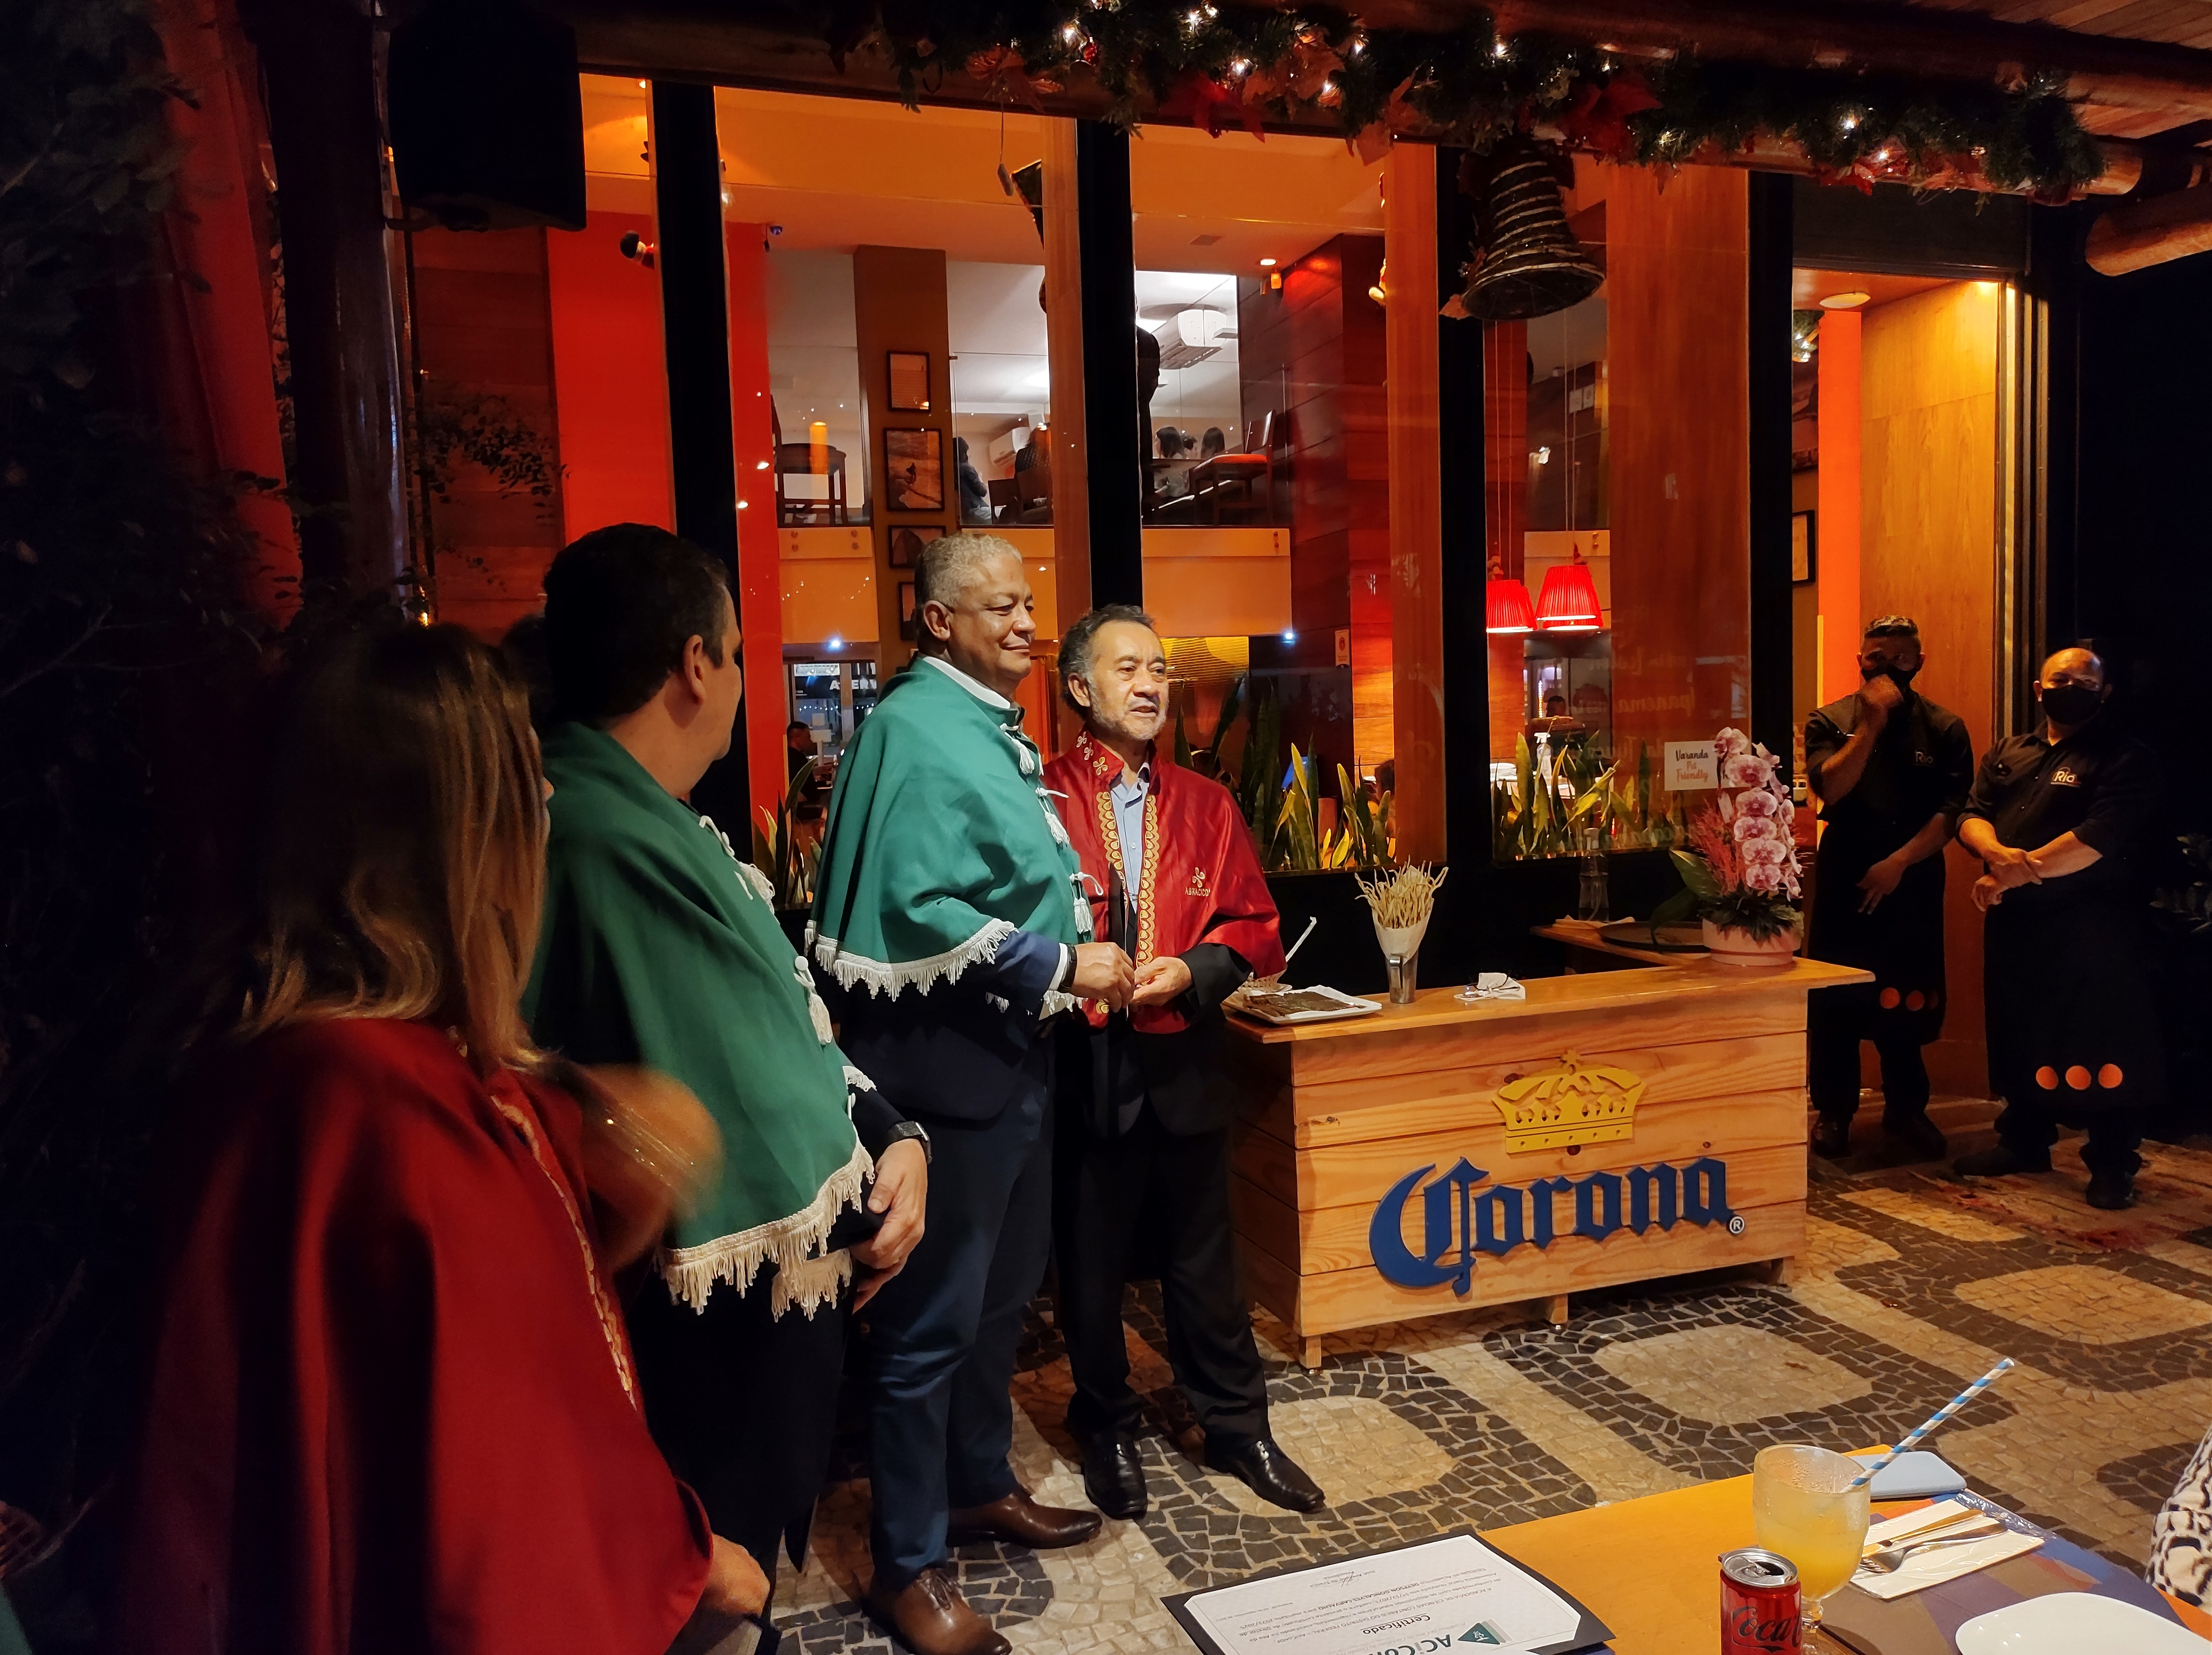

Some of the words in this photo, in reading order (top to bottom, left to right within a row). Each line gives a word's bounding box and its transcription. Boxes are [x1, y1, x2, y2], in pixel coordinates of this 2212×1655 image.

[1676, 749, 1709, 761] Varanda
[1676, 768, 1709, 783] Friendly
[1369, 1156, 1734, 1296] Corona
[1454, 1589, 1486, 1598] ACADEMIA
[1362, 1614, 1430, 1634] Certificado
